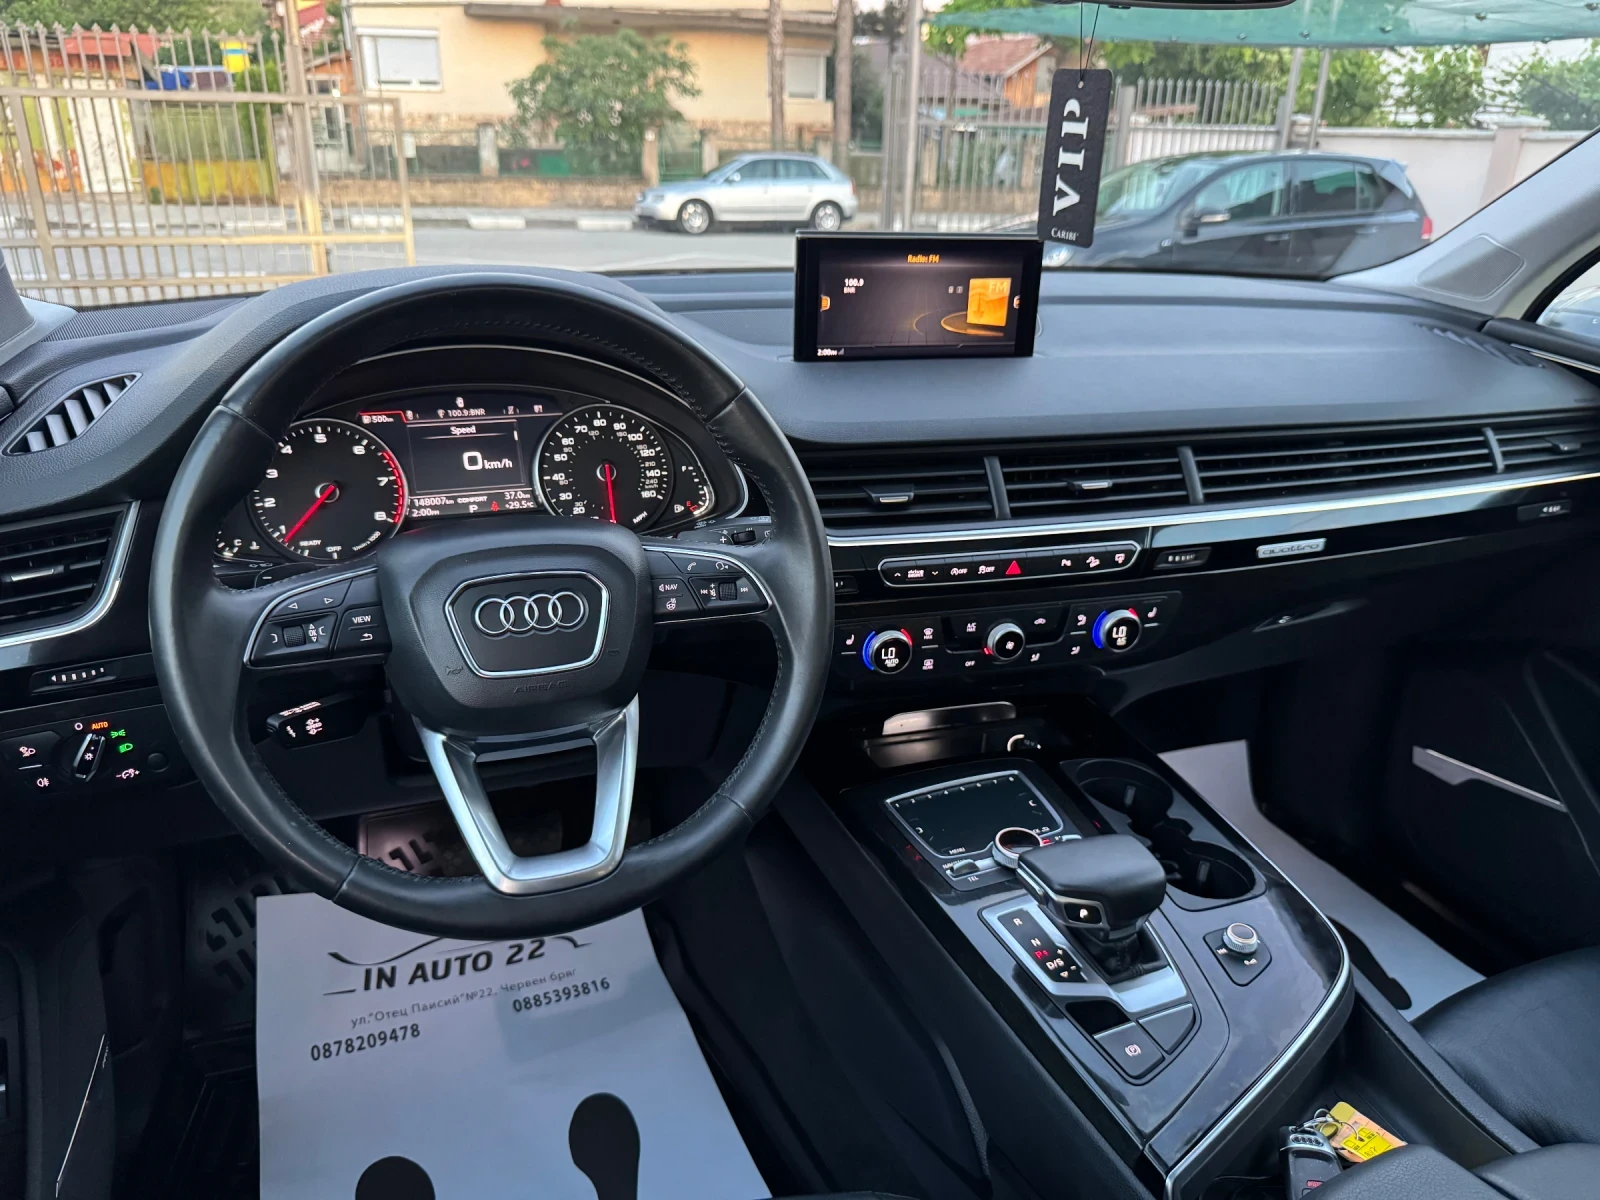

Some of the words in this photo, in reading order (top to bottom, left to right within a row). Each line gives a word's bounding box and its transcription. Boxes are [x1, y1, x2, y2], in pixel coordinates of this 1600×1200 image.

[1052, 98, 1088, 216] VIP
[907, 254, 928, 263] Radio:
[989, 281, 1008, 293] FM
[450, 425, 477, 436] Speed
[574, 425, 588, 433] 70
[314, 434, 328, 443] 5
[561, 437, 575, 445] 60
[627, 433, 643, 441] 100
[352, 446, 366, 455] 6
[640, 449, 655, 457] 120
[463, 451, 483, 470] 0
[484, 458, 513, 470] km/h
[553, 453, 568, 461] 50
[266, 469, 278, 478] 3
[645, 469, 661, 477] 140
[376, 477, 389, 487] 7
[559, 492, 572, 500] 30
[263, 497, 276, 508] 2
[468, 504, 478, 513] P
[573, 506, 586, 515] 20
[374, 511, 387, 521] 8
[632, 511, 648, 524] MPH
[1262, 544, 1319, 554] quattro
[665, 583, 678, 591] NAV
[352, 615, 371, 624] VIEW
[881, 647, 896, 659] LO
[91, 721, 109, 730] AUTO
[967, 875, 979, 883] TEL
[1080, 908, 1088, 919] P
[1013, 917, 1023, 926] R
[1031, 938, 1041, 947] N
[363, 964, 397, 991] IN
[408, 949, 493, 985] AUTO
[506, 937, 545, 966] 22
[1046, 958, 1064, 970] D/S
[501, 975, 547, 992] Червен
[512, 977, 611, 1013] 0885393816
[310, 1023, 421, 1061] 0878209478
